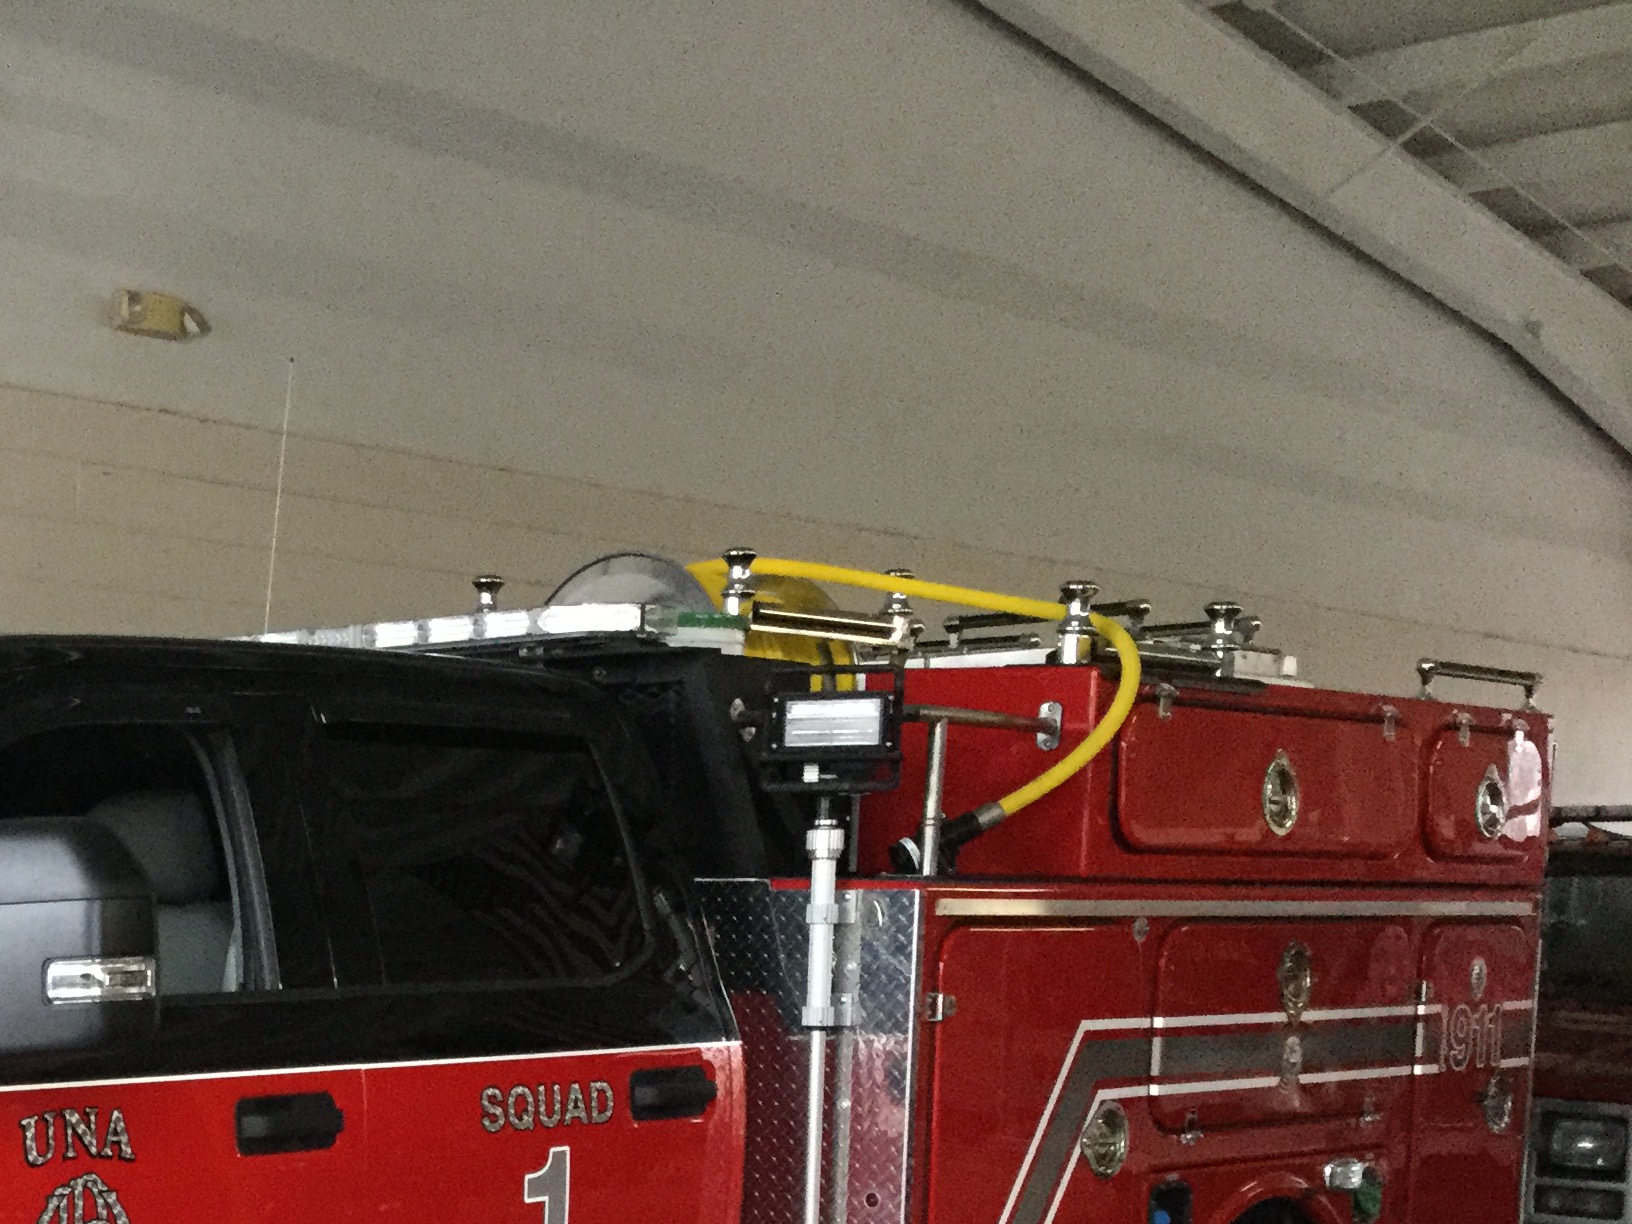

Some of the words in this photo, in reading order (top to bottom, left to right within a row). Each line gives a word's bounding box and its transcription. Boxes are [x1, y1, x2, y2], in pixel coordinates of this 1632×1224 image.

[1437, 1003, 1503, 1073] 1911
[20, 1106, 136, 1168] UNA
[481, 1080, 614, 1133] SQUAD
